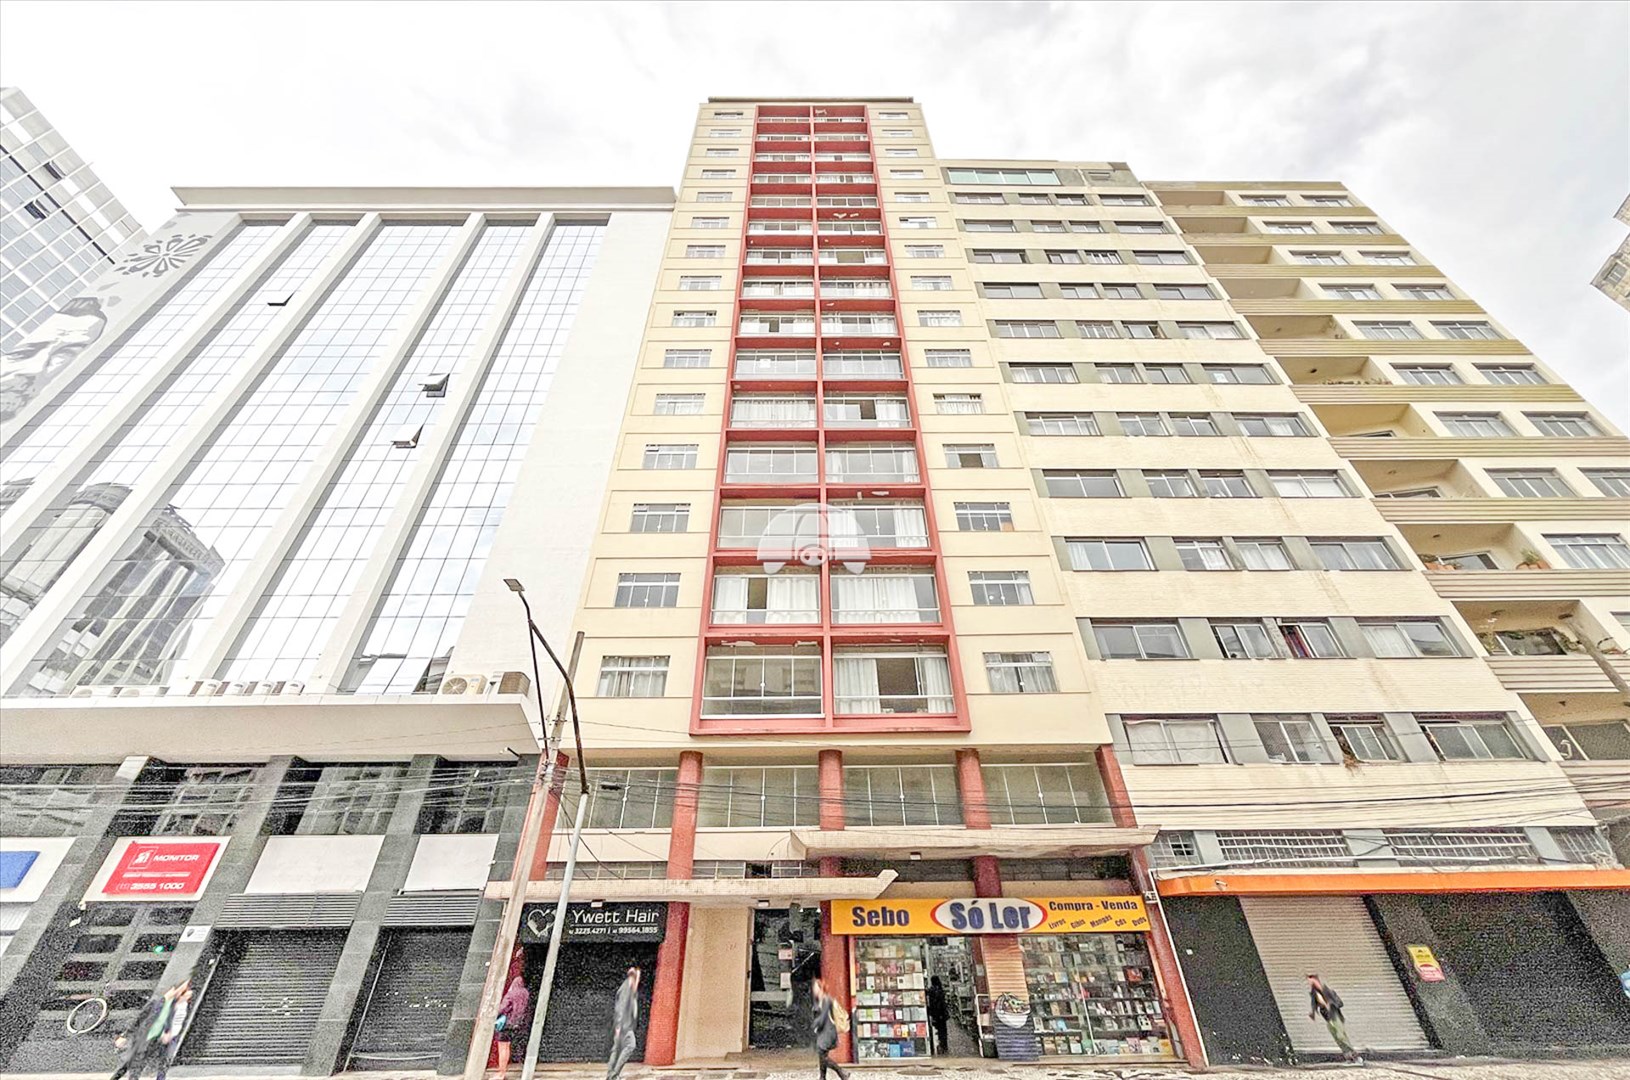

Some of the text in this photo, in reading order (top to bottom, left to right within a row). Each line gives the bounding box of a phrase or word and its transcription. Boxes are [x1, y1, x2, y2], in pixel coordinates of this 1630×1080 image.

[152, 854, 199, 862] MONITOR
[159, 882, 185, 890] 1000
[1049, 901, 1094, 911] Compra
[1101, 900, 1138, 910] Venda
[572, 909, 659, 924] Ywett Hair
[852, 906, 910, 927] Sebo
[950, 900, 1031, 929] Só Ler
[1048, 918, 1066, 930] Livros
